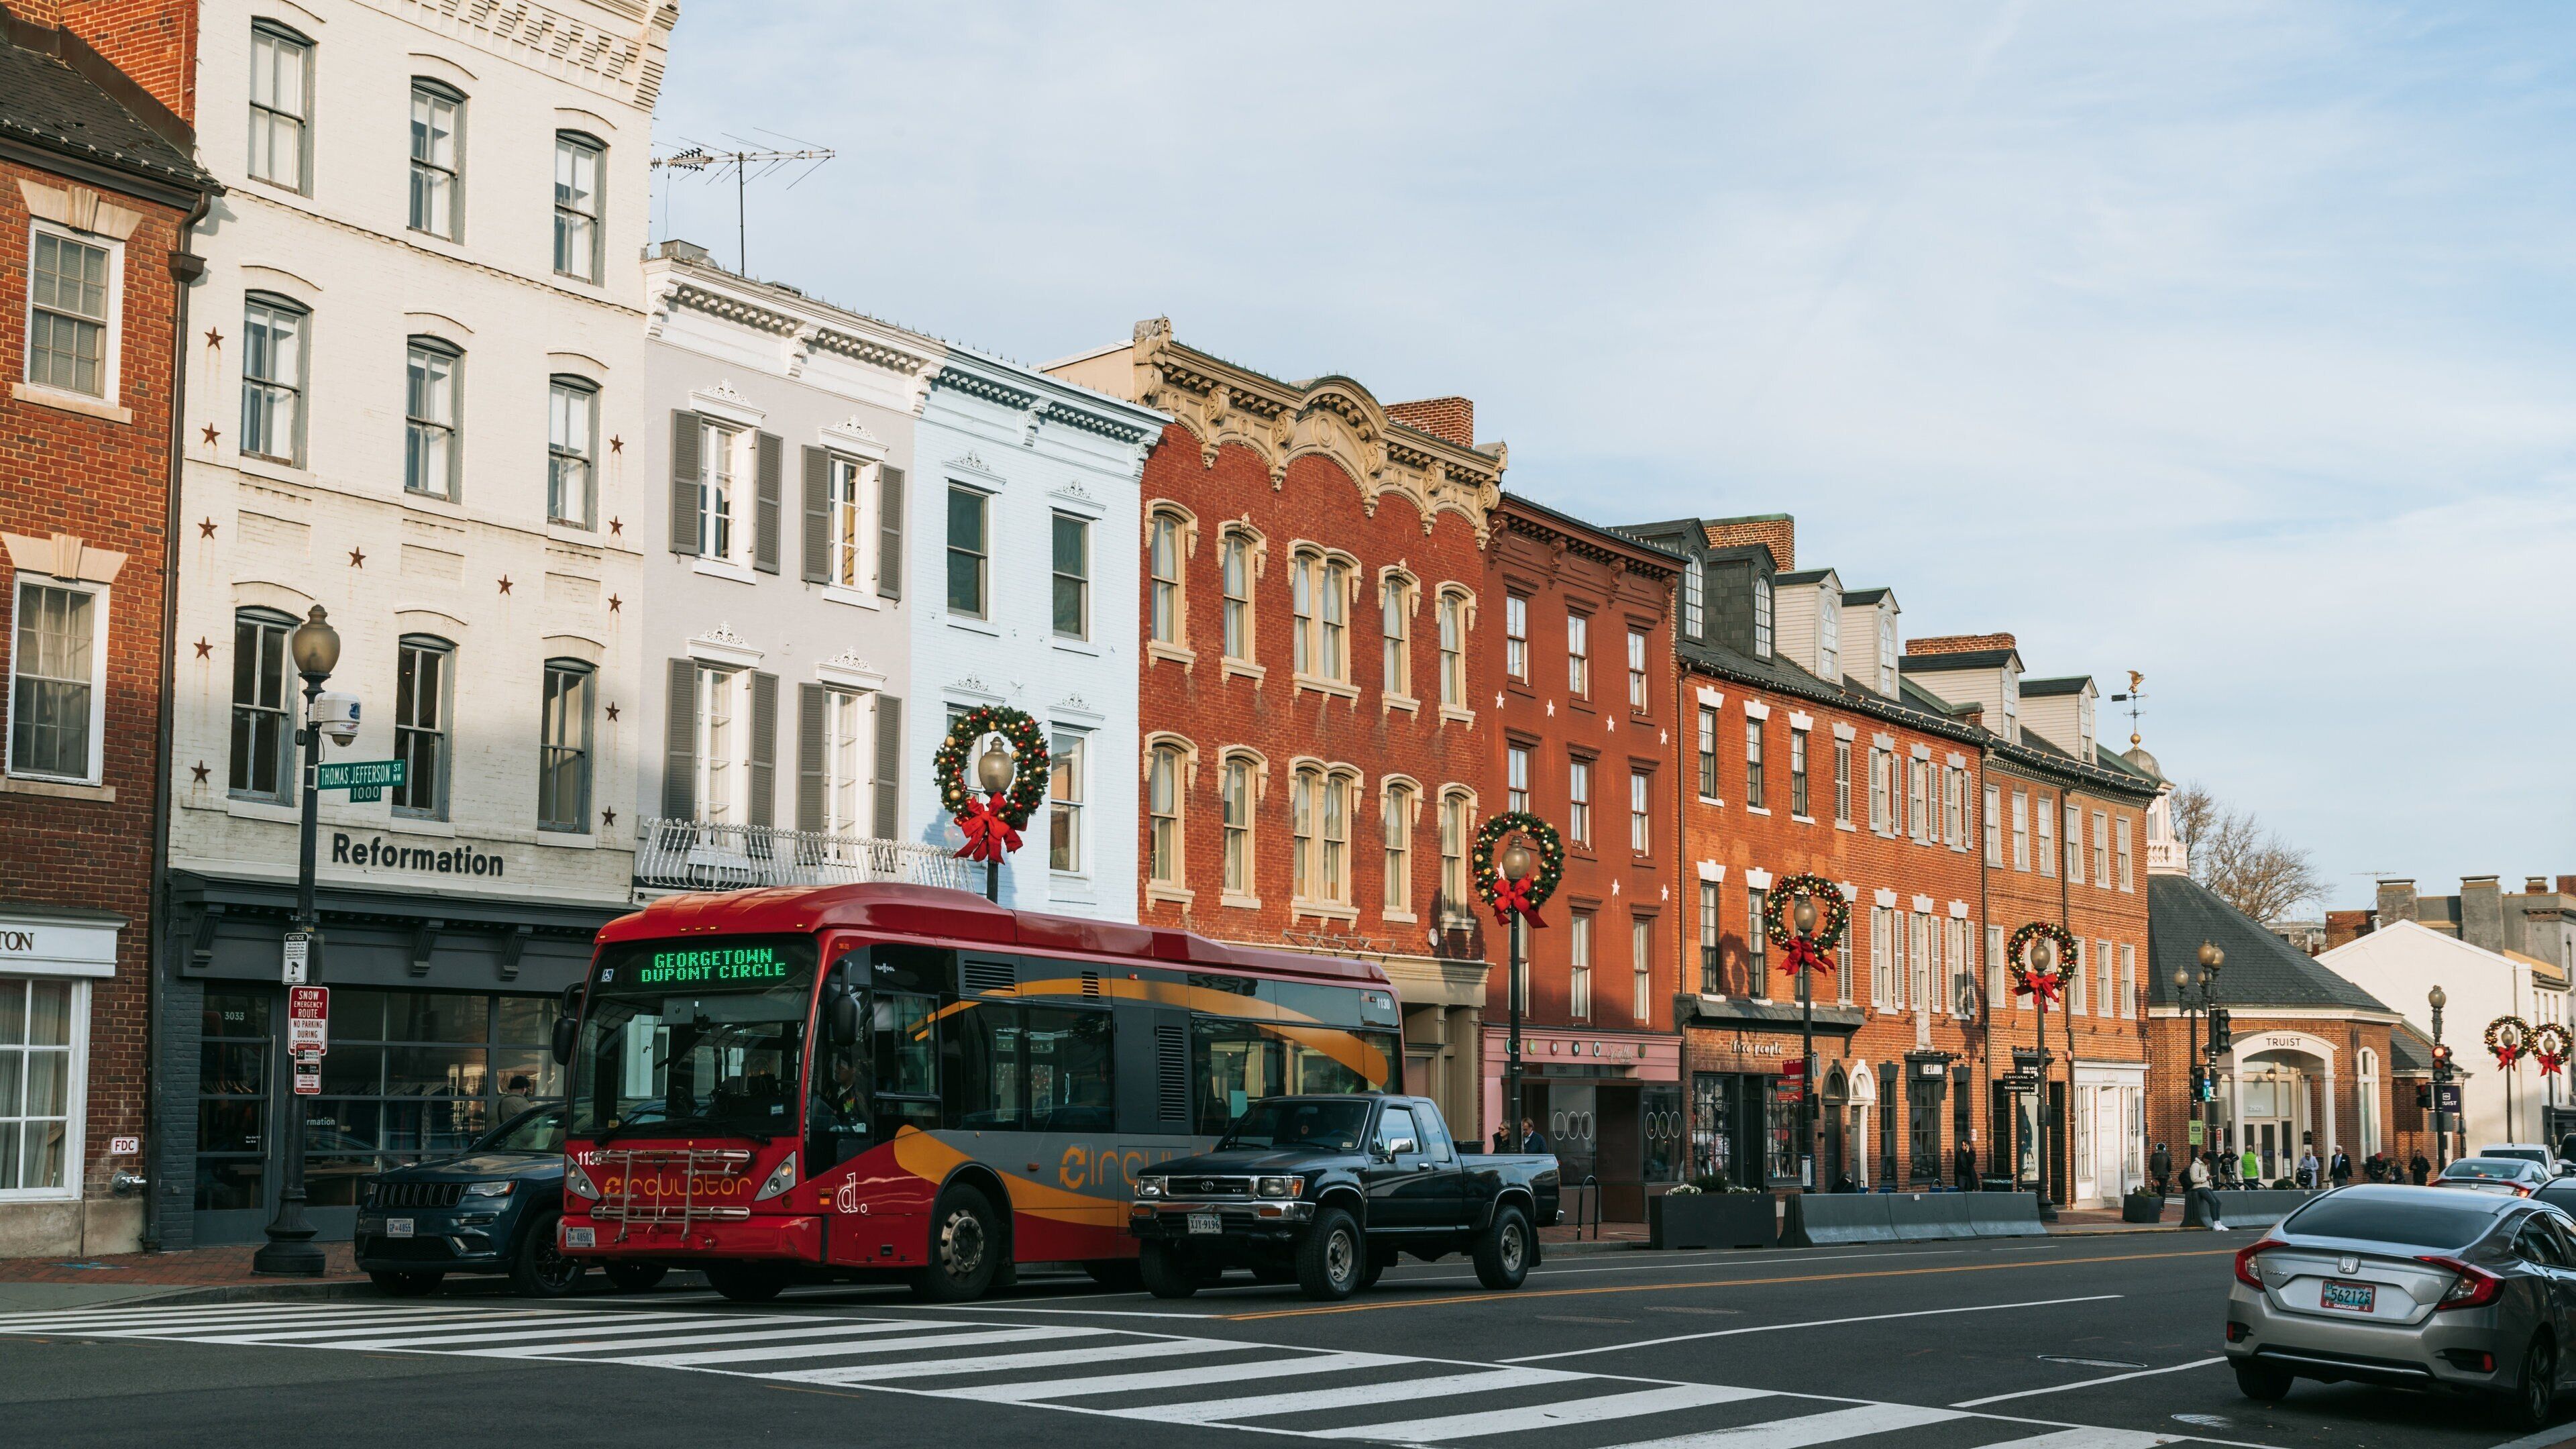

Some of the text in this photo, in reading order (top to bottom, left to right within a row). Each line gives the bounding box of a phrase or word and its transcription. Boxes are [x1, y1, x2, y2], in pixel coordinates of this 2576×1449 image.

[321, 763, 401, 786] THOMAS JEFFERSON ST
[392, 773, 402, 782] NW
[354, 786, 379, 800] 1000
[332, 833, 503, 876] Reformation
[654, 948, 772, 968] GEORGETOWN
[641, 963, 786, 982] DUPONT CIRCLE
[299, 990, 319, 1000] SNOW
[294, 1000, 323, 1008] EMERGENCY
[1377, 998, 1391, 1010] 1130
[224, 1011, 244, 1020] 3033
[298, 1008, 318, 1018] ROUTE
[293, 1020, 323, 1028] NO PARKING
[297, 1030, 318, 1038] DURING
[2266, 1038, 2301, 1046] TRUIST
[1753, 1041, 1783, 1057] people
[307, 1117, 335, 1126] rmation
[115, 1140, 134, 1151] FDC
[1190, 1219, 1220, 1229] XJY-9196
